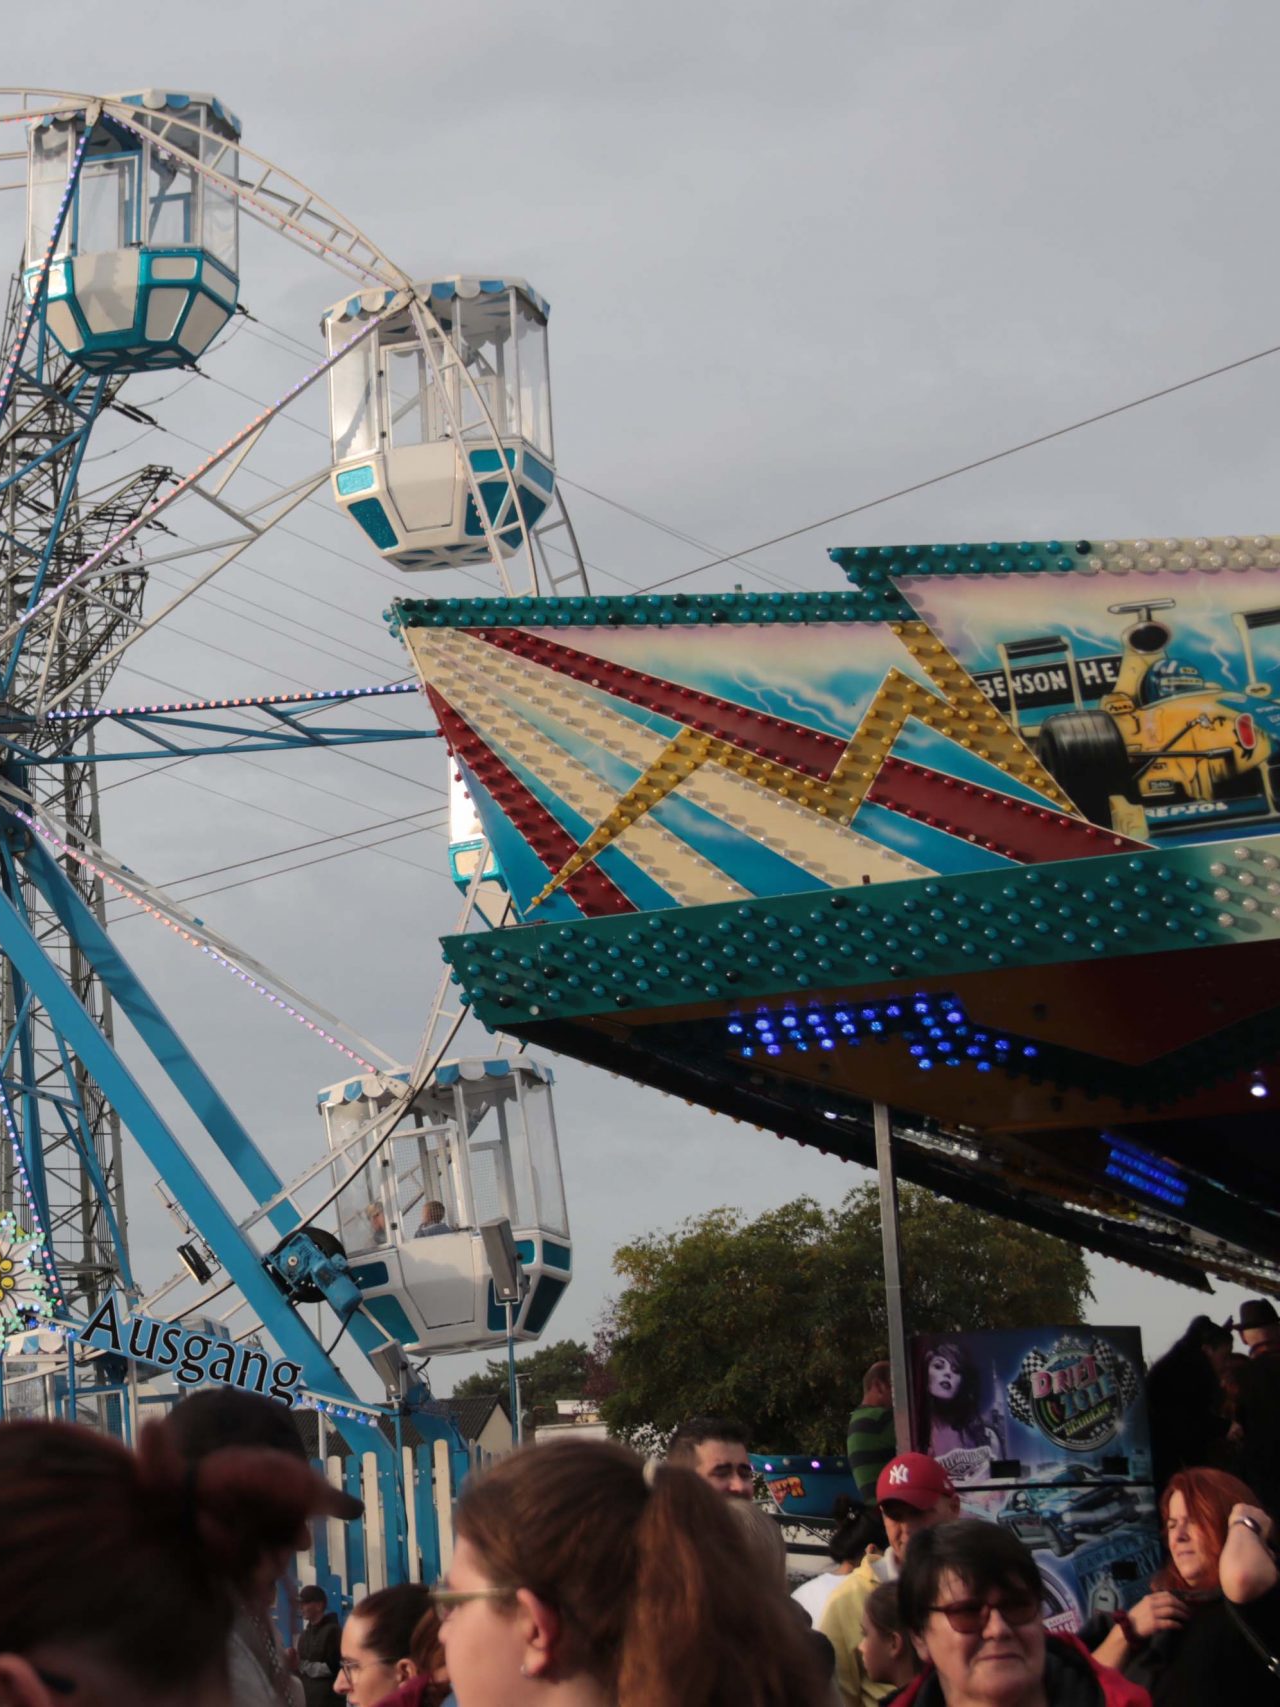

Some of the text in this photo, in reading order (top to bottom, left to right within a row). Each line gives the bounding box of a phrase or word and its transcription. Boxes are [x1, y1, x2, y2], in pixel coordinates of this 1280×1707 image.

[977, 669, 1068, 699] BENSON
[79, 1294, 302, 1408] Ausgang
[1030, 1354, 1099, 1399] DRIFT
[889, 1463, 909, 1485] NY
